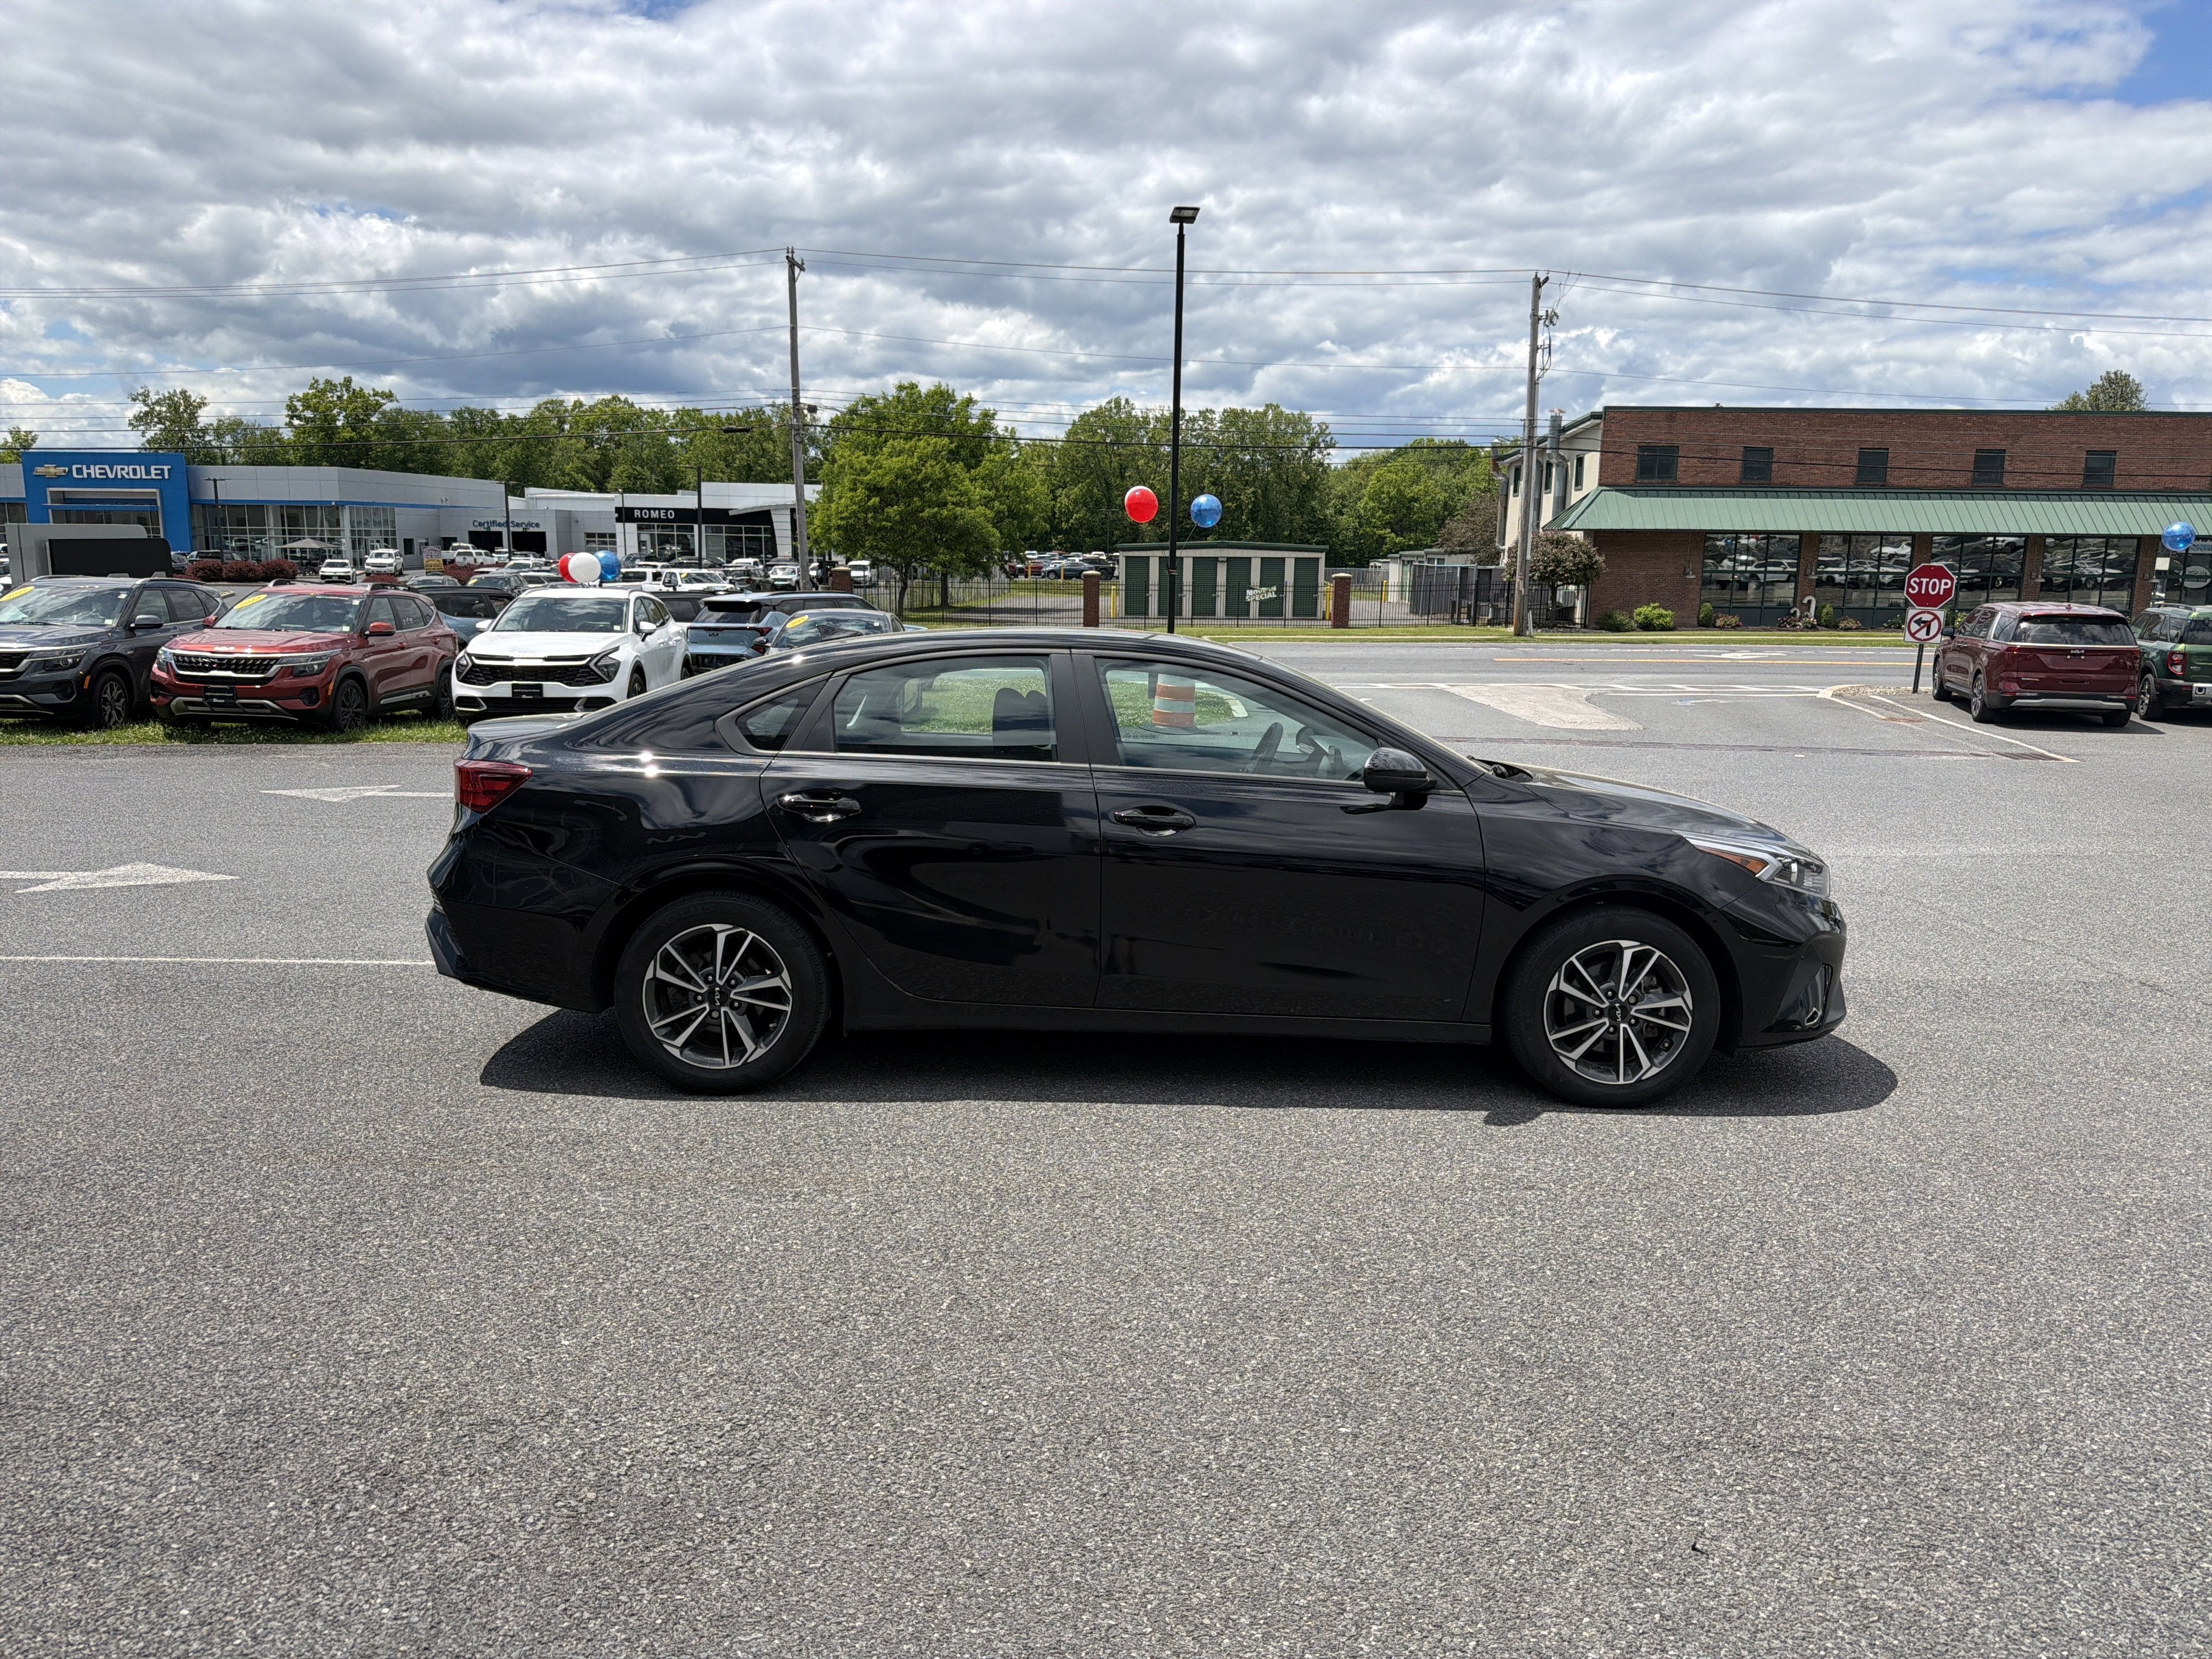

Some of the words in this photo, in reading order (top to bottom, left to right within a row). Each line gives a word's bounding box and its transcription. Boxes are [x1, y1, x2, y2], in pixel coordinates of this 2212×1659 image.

[72, 465, 172, 479] CHEVROLET
[634, 509, 675, 519] ROMEO
[1908, 577, 1951, 595] STOP
[1245, 591, 1277, 602] SPECIAL
